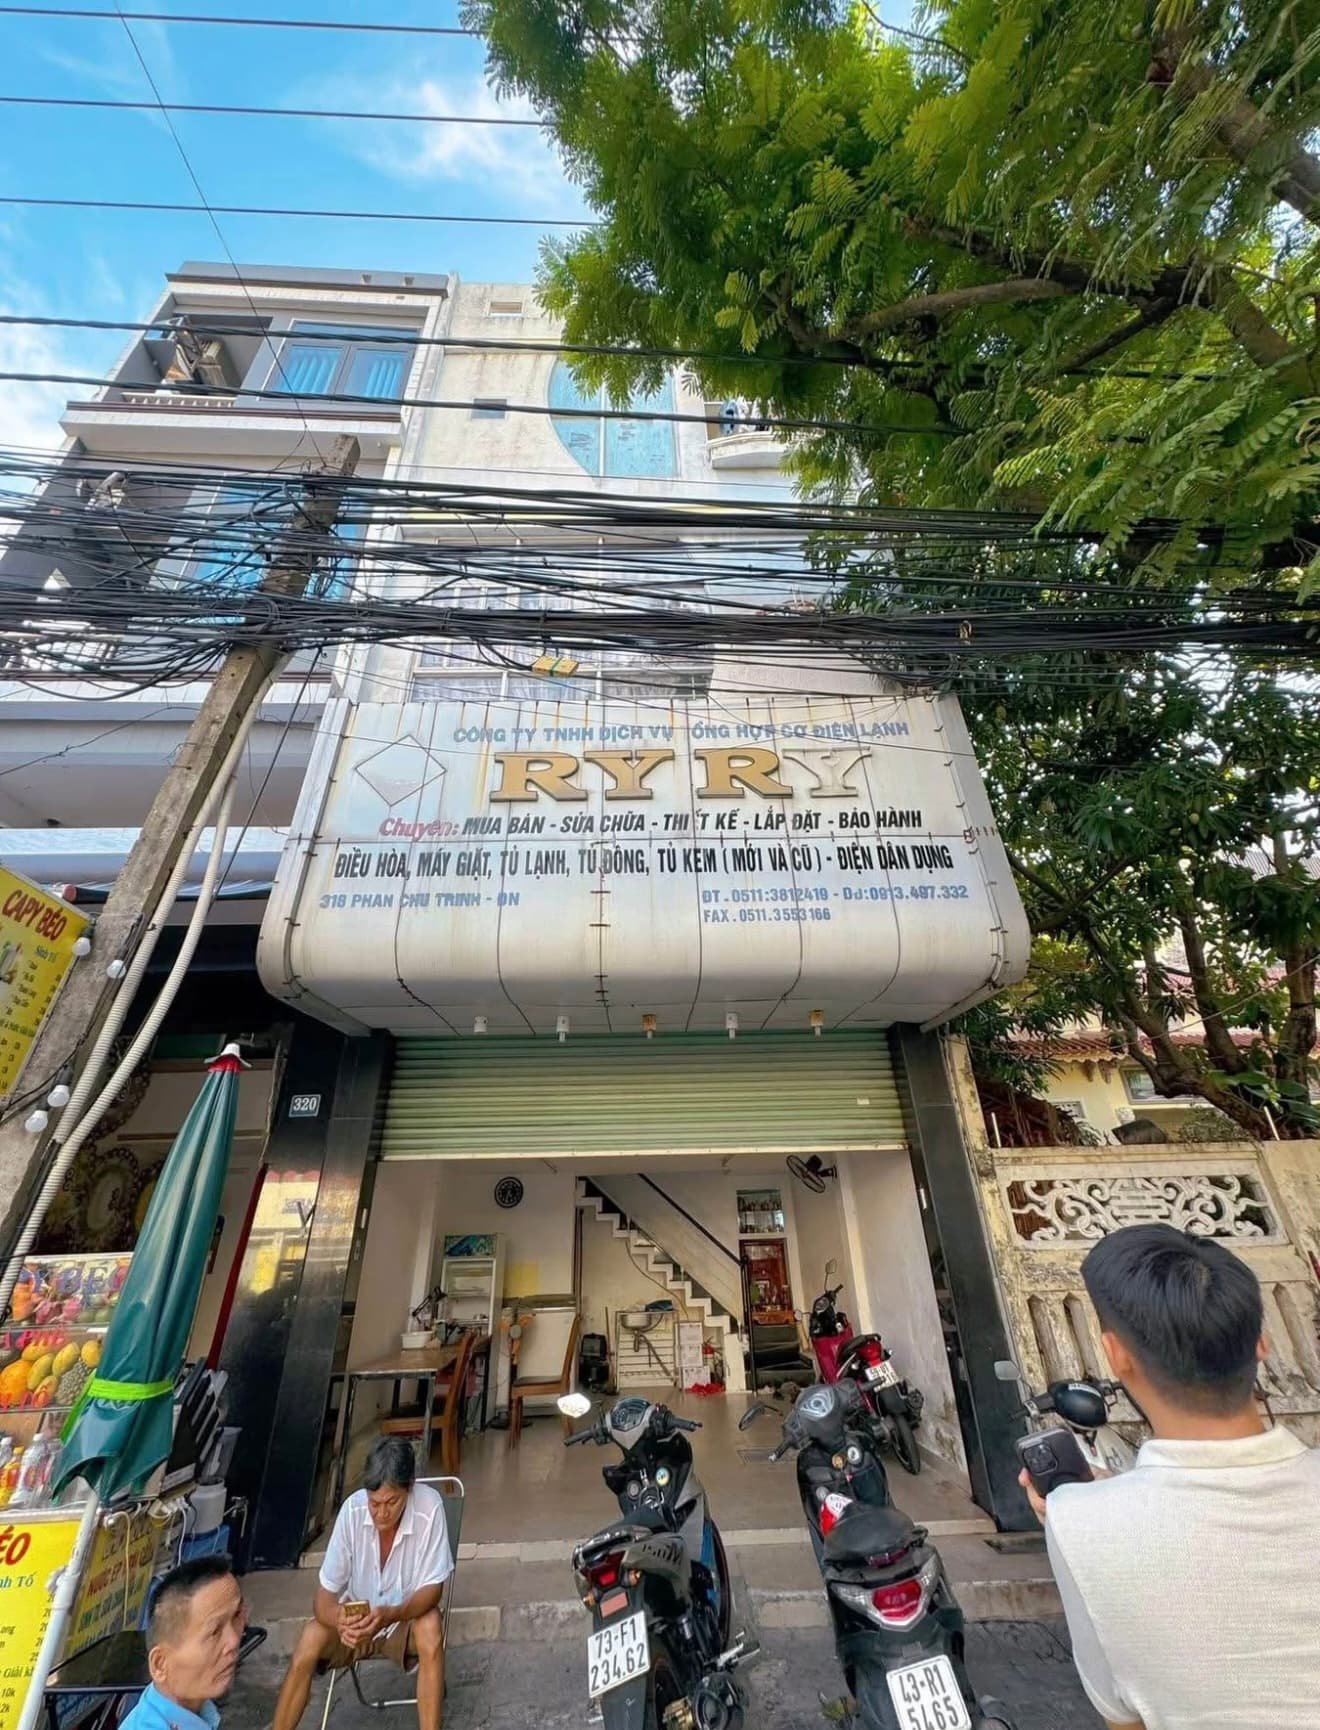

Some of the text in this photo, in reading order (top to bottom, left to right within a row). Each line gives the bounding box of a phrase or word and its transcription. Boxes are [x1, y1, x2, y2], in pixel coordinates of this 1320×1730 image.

[452, 726, 507, 743] CÔNG
[511, 727, 538, 743] TY
[543, 726, 594, 742] TNHH
[650, 725, 675, 742] VỤ
[780, 723, 808, 739] CƠ
[860, 720, 910, 741] LẠNH
[378, 817, 460, 843] Chuyên:
[461, 816, 503, 836] MUA
[507, 812, 546, 835] BÁN
[599, 809, 646, 835] CHỮA
[715, 807, 742, 831] KẾ
[753, 805, 786, 831] LẮP
[791, 809, 823, 833] ĐẶT
[838, 806, 870, 830] BẢO
[876, 805, 923, 830] HÀNH
[333, 846, 372, 879] ĐIỀU
[374, 847, 411, 882] HÒA,
[415, 846, 452, 879] MÁY
[455, 847, 492, 881] GIẶT,
[499, 845, 520, 877] TỦ
[524, 849, 571, 881] LẠNH,
[656, 841, 677, 873] TỦ
[682, 847, 718, 873] KEM
[767, 842, 790, 872] VÀ
[836, 842, 875, 875] ĐIỆN
[878, 841, 911, 871] DÂN
[912, 844, 955, 874] DỤNG
[2, 889, 68, 942] CAPY BÉO
[319, 893, 347, 910] 318
[350, 893, 395, 909] PHAN
[434, 892, 482, 908] TRINH
[293, 1097, 317, 1111] 320
[595, 1617, 637, 1659] 73-F1
[591, 1642, 646, 1692] 234.62
[899, 1664, 947, 1704] 43-R1
